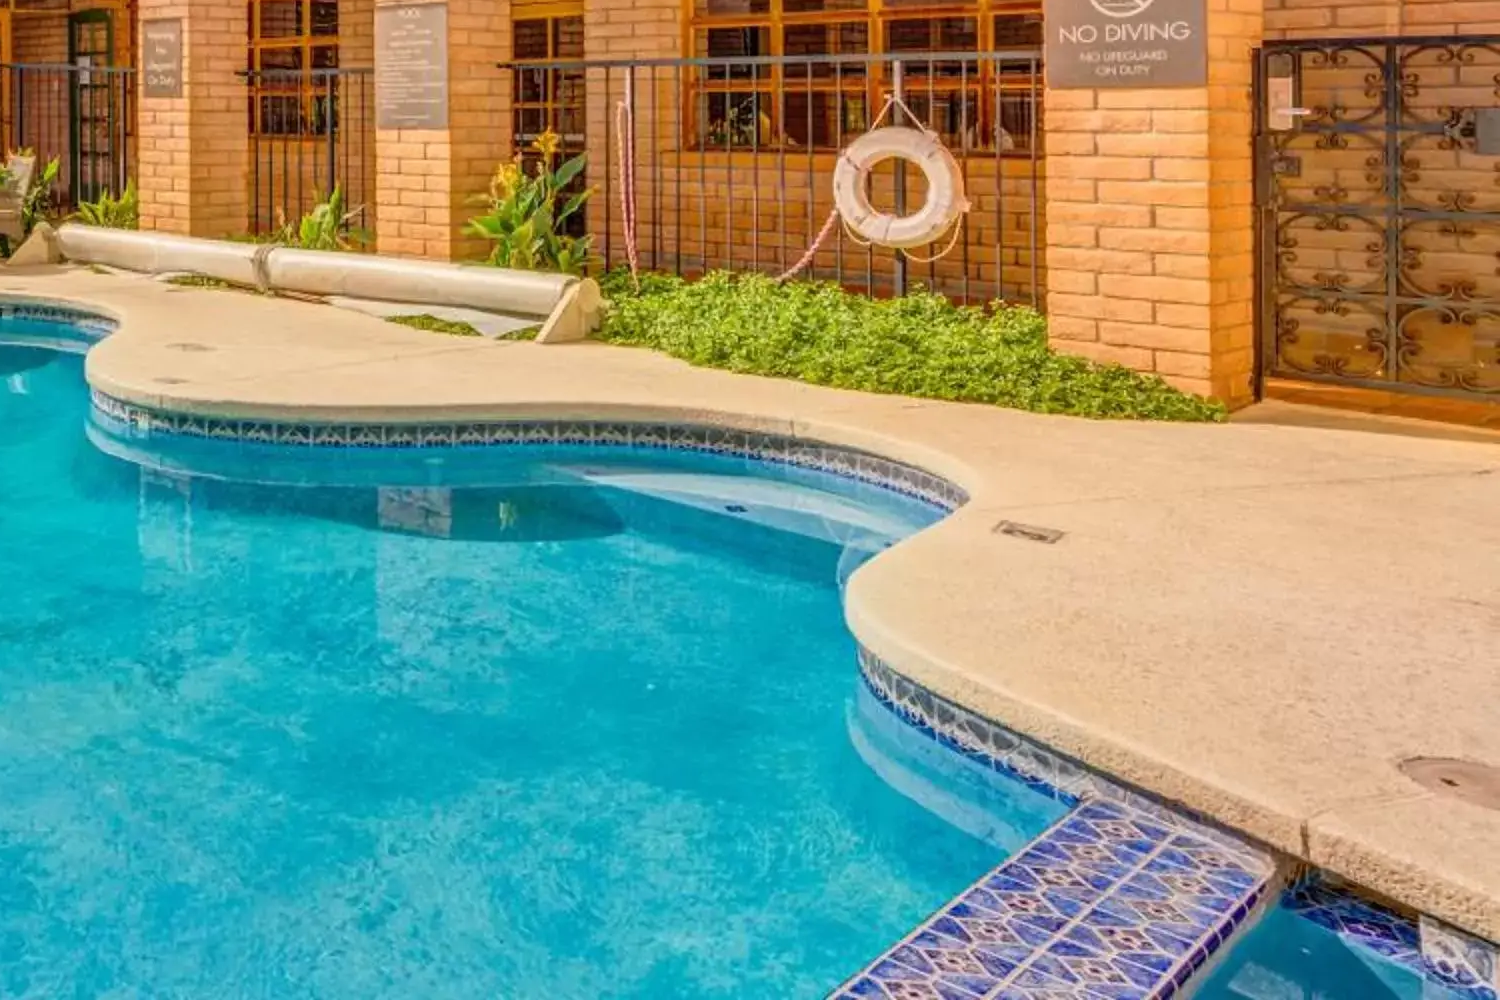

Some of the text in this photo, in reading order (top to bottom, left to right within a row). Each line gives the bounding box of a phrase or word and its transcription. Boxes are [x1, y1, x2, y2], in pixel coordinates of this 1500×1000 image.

[1059, 21, 1192, 44] NO DIVING
[1079, 50, 1168, 62] NO LIFEGUARD
[1096, 64, 1151, 76] ON DUTY
